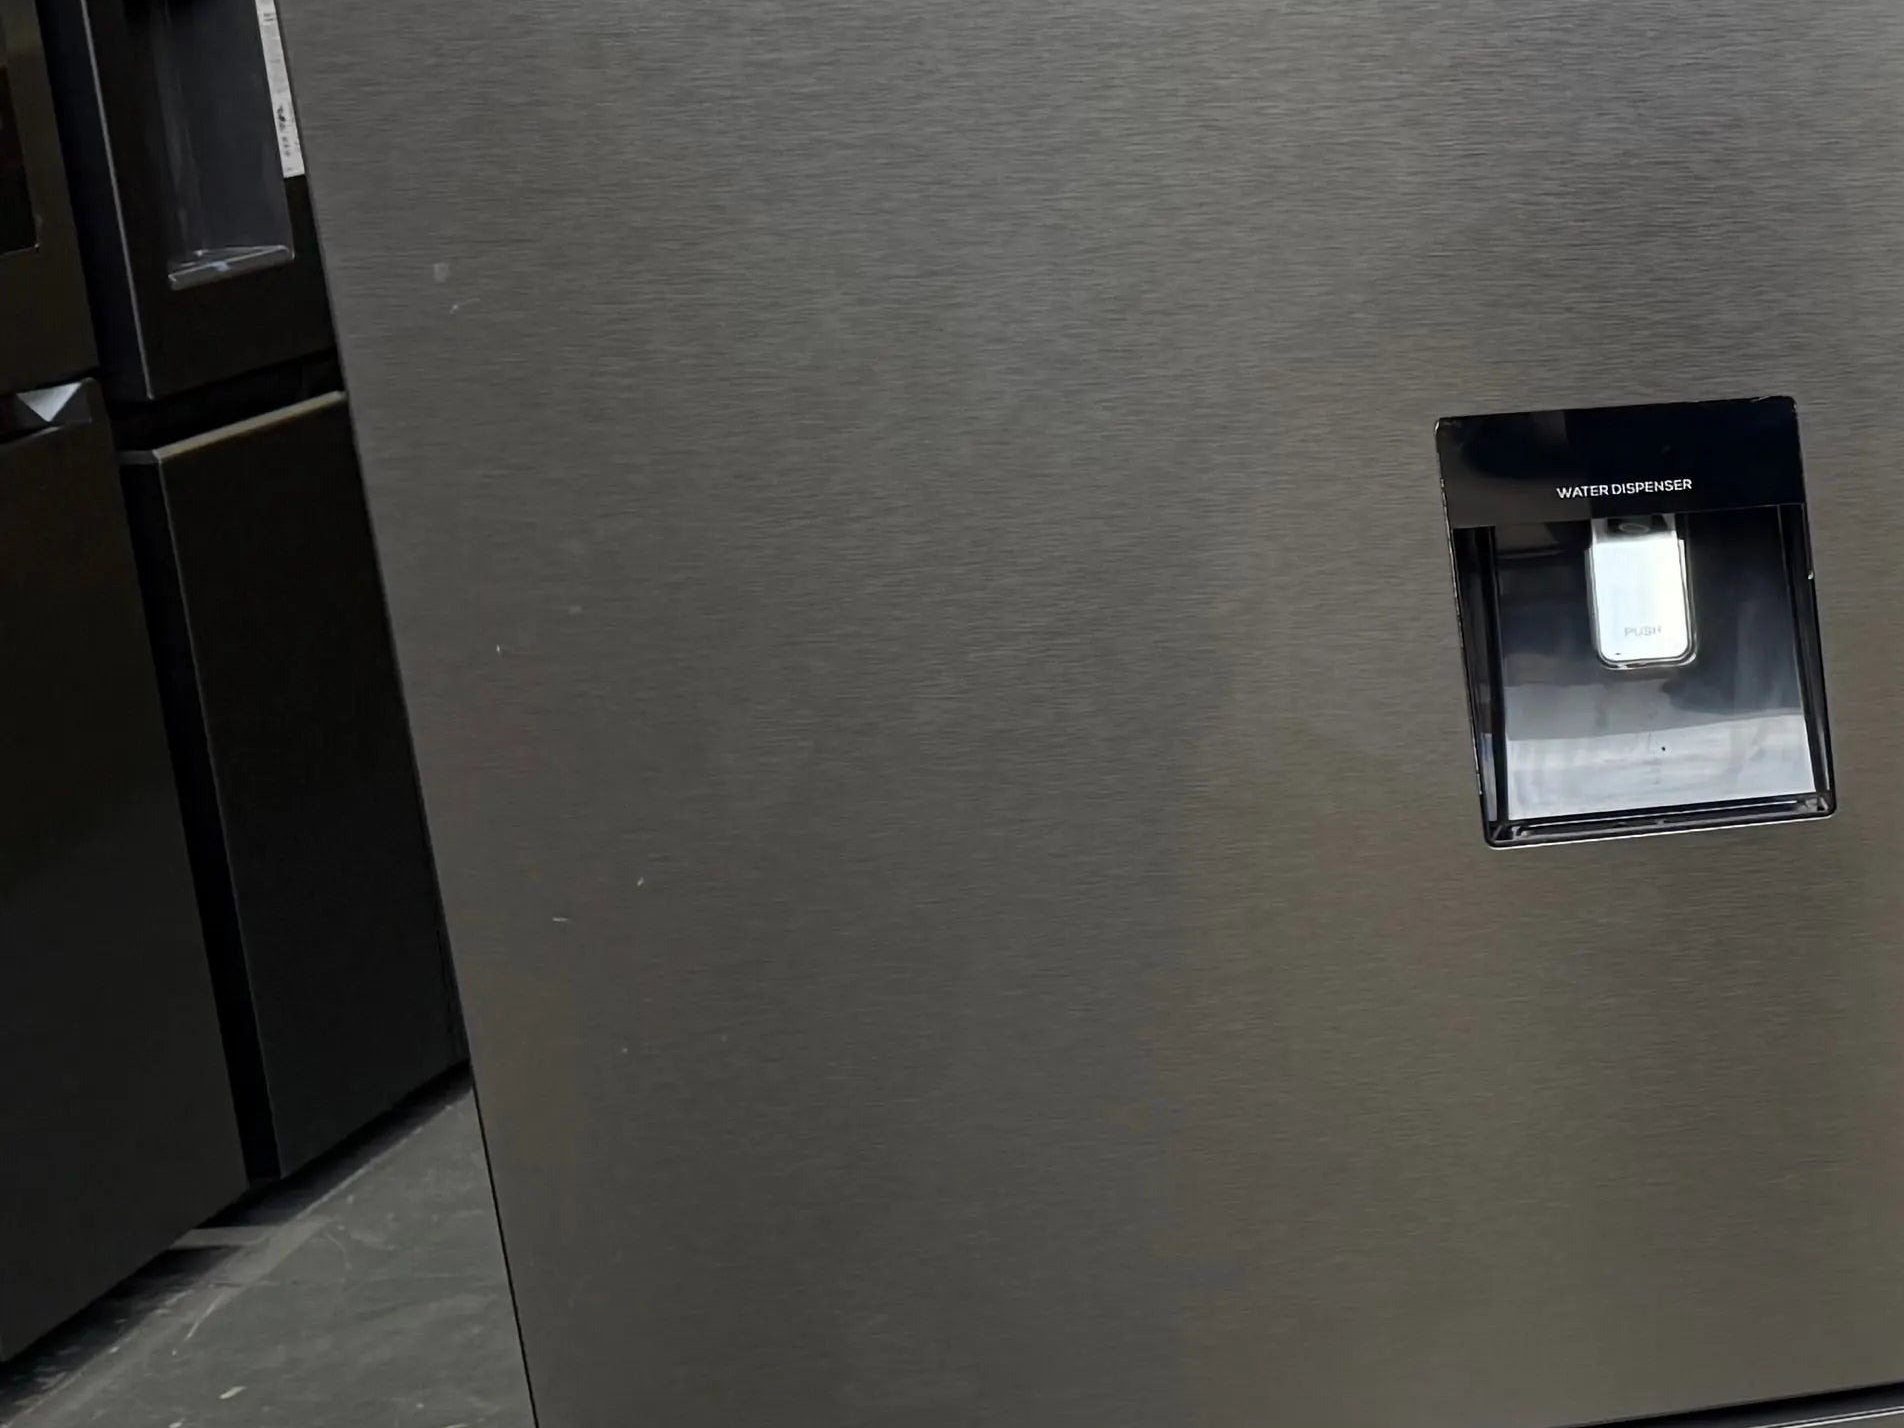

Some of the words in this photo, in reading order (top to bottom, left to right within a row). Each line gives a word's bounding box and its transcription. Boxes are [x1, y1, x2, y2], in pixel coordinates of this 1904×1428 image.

[1557, 485, 1608, 498] WATER
[1611, 479, 1692, 494] DISPENSER
[1624, 625, 1663, 638] PUSH
